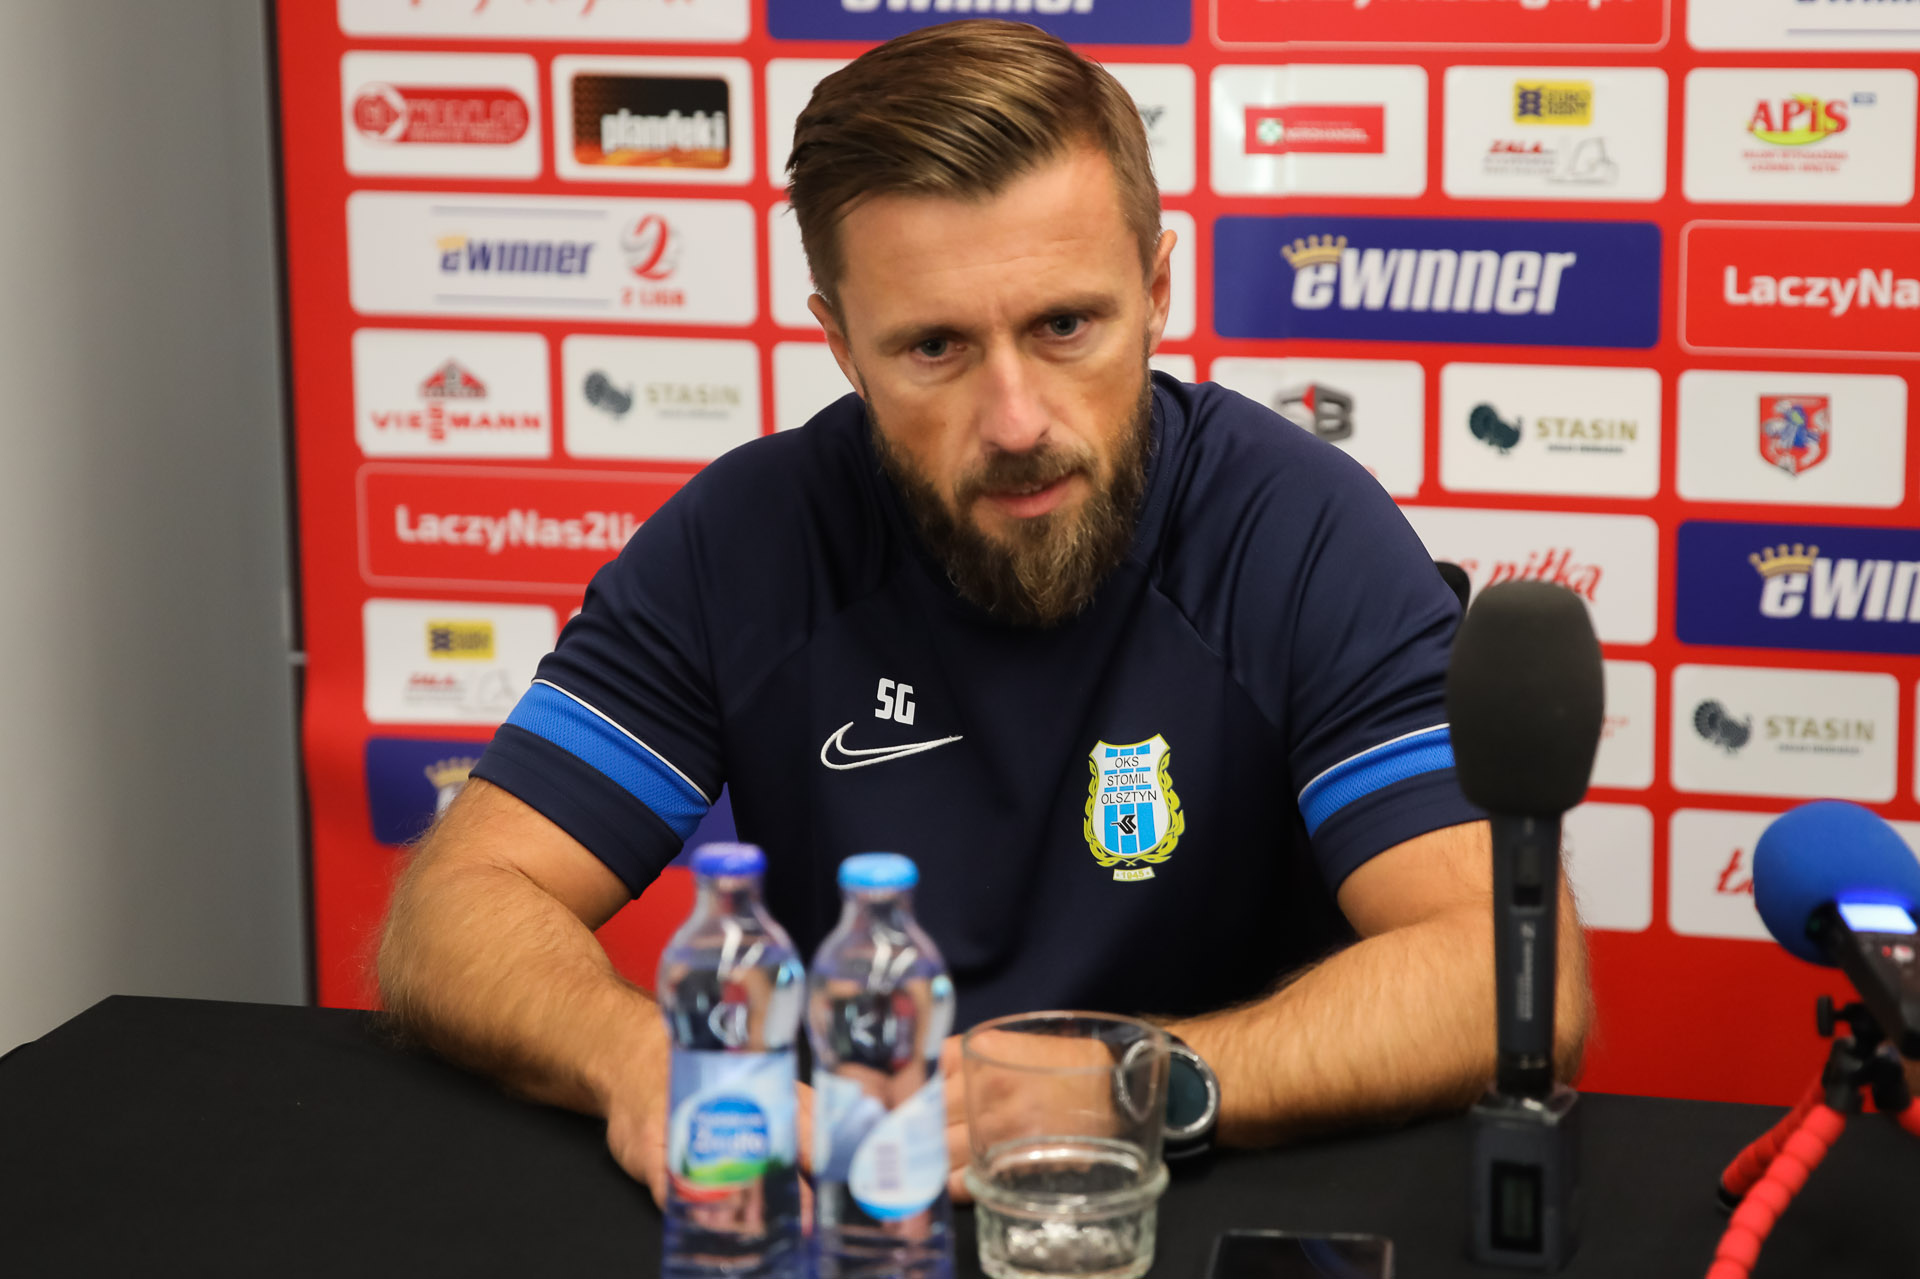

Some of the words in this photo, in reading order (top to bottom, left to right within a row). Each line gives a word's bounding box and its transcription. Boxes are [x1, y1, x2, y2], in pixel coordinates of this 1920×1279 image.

[1536, 416, 1638, 441] STASIN
[875, 677, 916, 726] SG
[1765, 715, 1876, 741] STASIN
[1114, 756, 1139, 769] OKS
[1107, 773, 1148, 787] STOMIL
[1101, 790, 1157, 805] OLSZTYN
